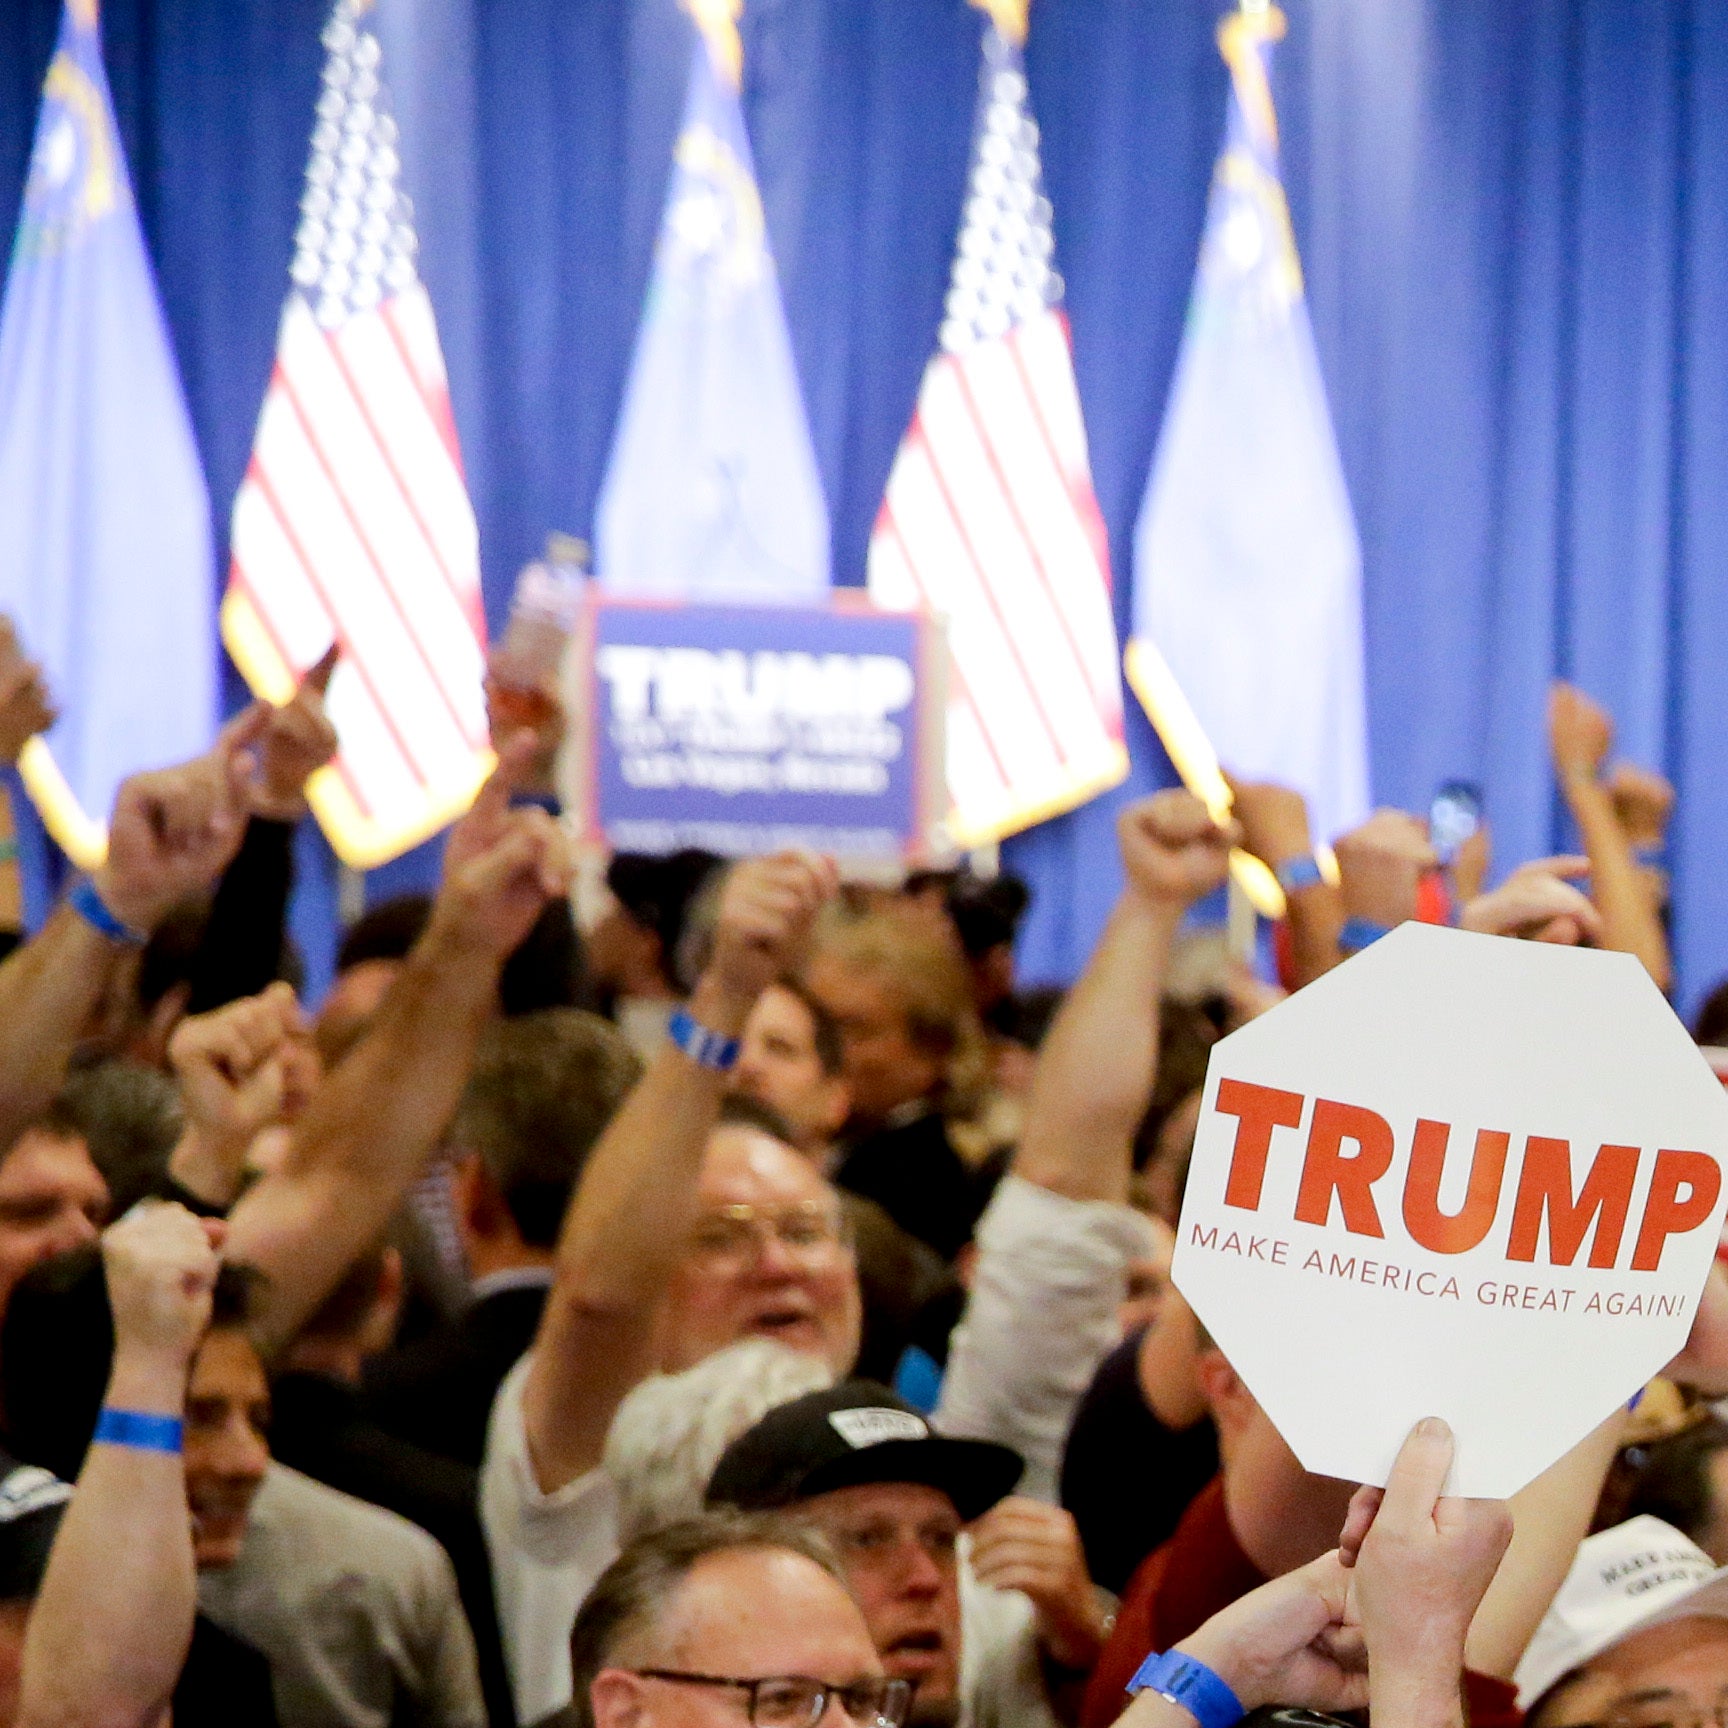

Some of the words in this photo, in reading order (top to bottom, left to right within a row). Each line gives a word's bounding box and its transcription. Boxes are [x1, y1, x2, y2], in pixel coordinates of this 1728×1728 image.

[596, 645, 915, 722] TRUMP
[1214, 1076, 1722, 1273] TRUMP
[1190, 1223, 1290, 1265] MAKE
[1302, 1250, 1462, 1301] AMERICA
[1476, 1281, 1576, 1314] GREAT
[1584, 1291, 1688, 1318] AGAIN!
